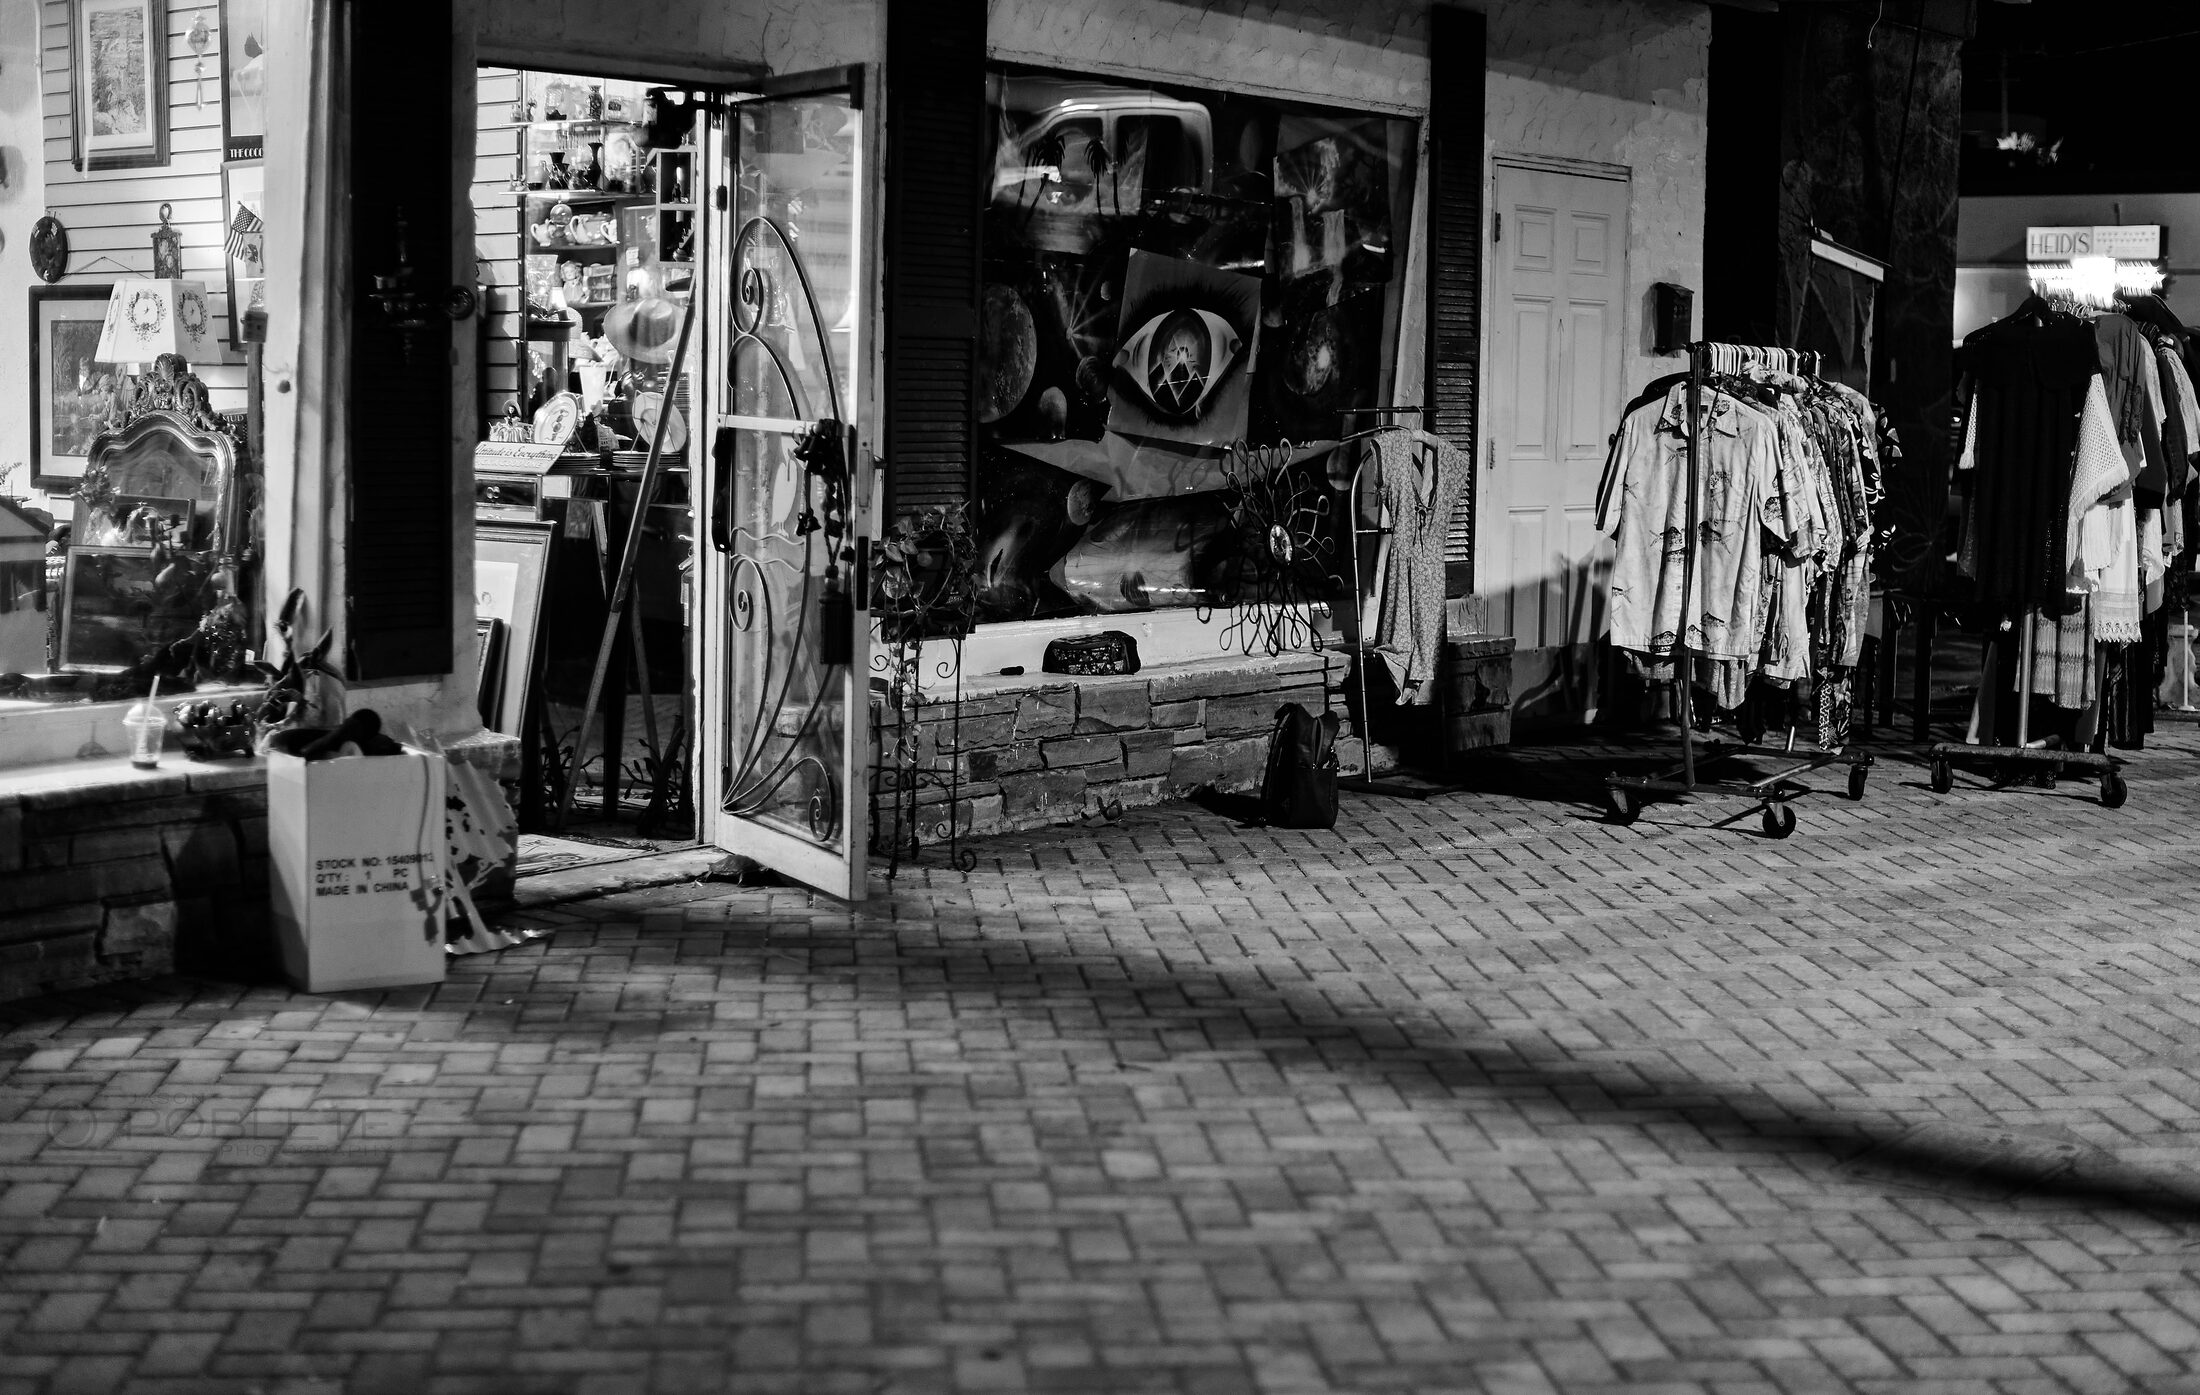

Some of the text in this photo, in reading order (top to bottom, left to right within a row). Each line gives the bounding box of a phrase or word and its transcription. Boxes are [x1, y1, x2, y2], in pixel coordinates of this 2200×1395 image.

[229, 148, 244, 158] THE
[513, 445, 558, 461] Everything
[316, 859, 355, 870] STOCK
[364, 870, 372, 880] 1
[393, 868, 409, 878] PC
[316, 881, 409, 896] MADE IN CHINA
